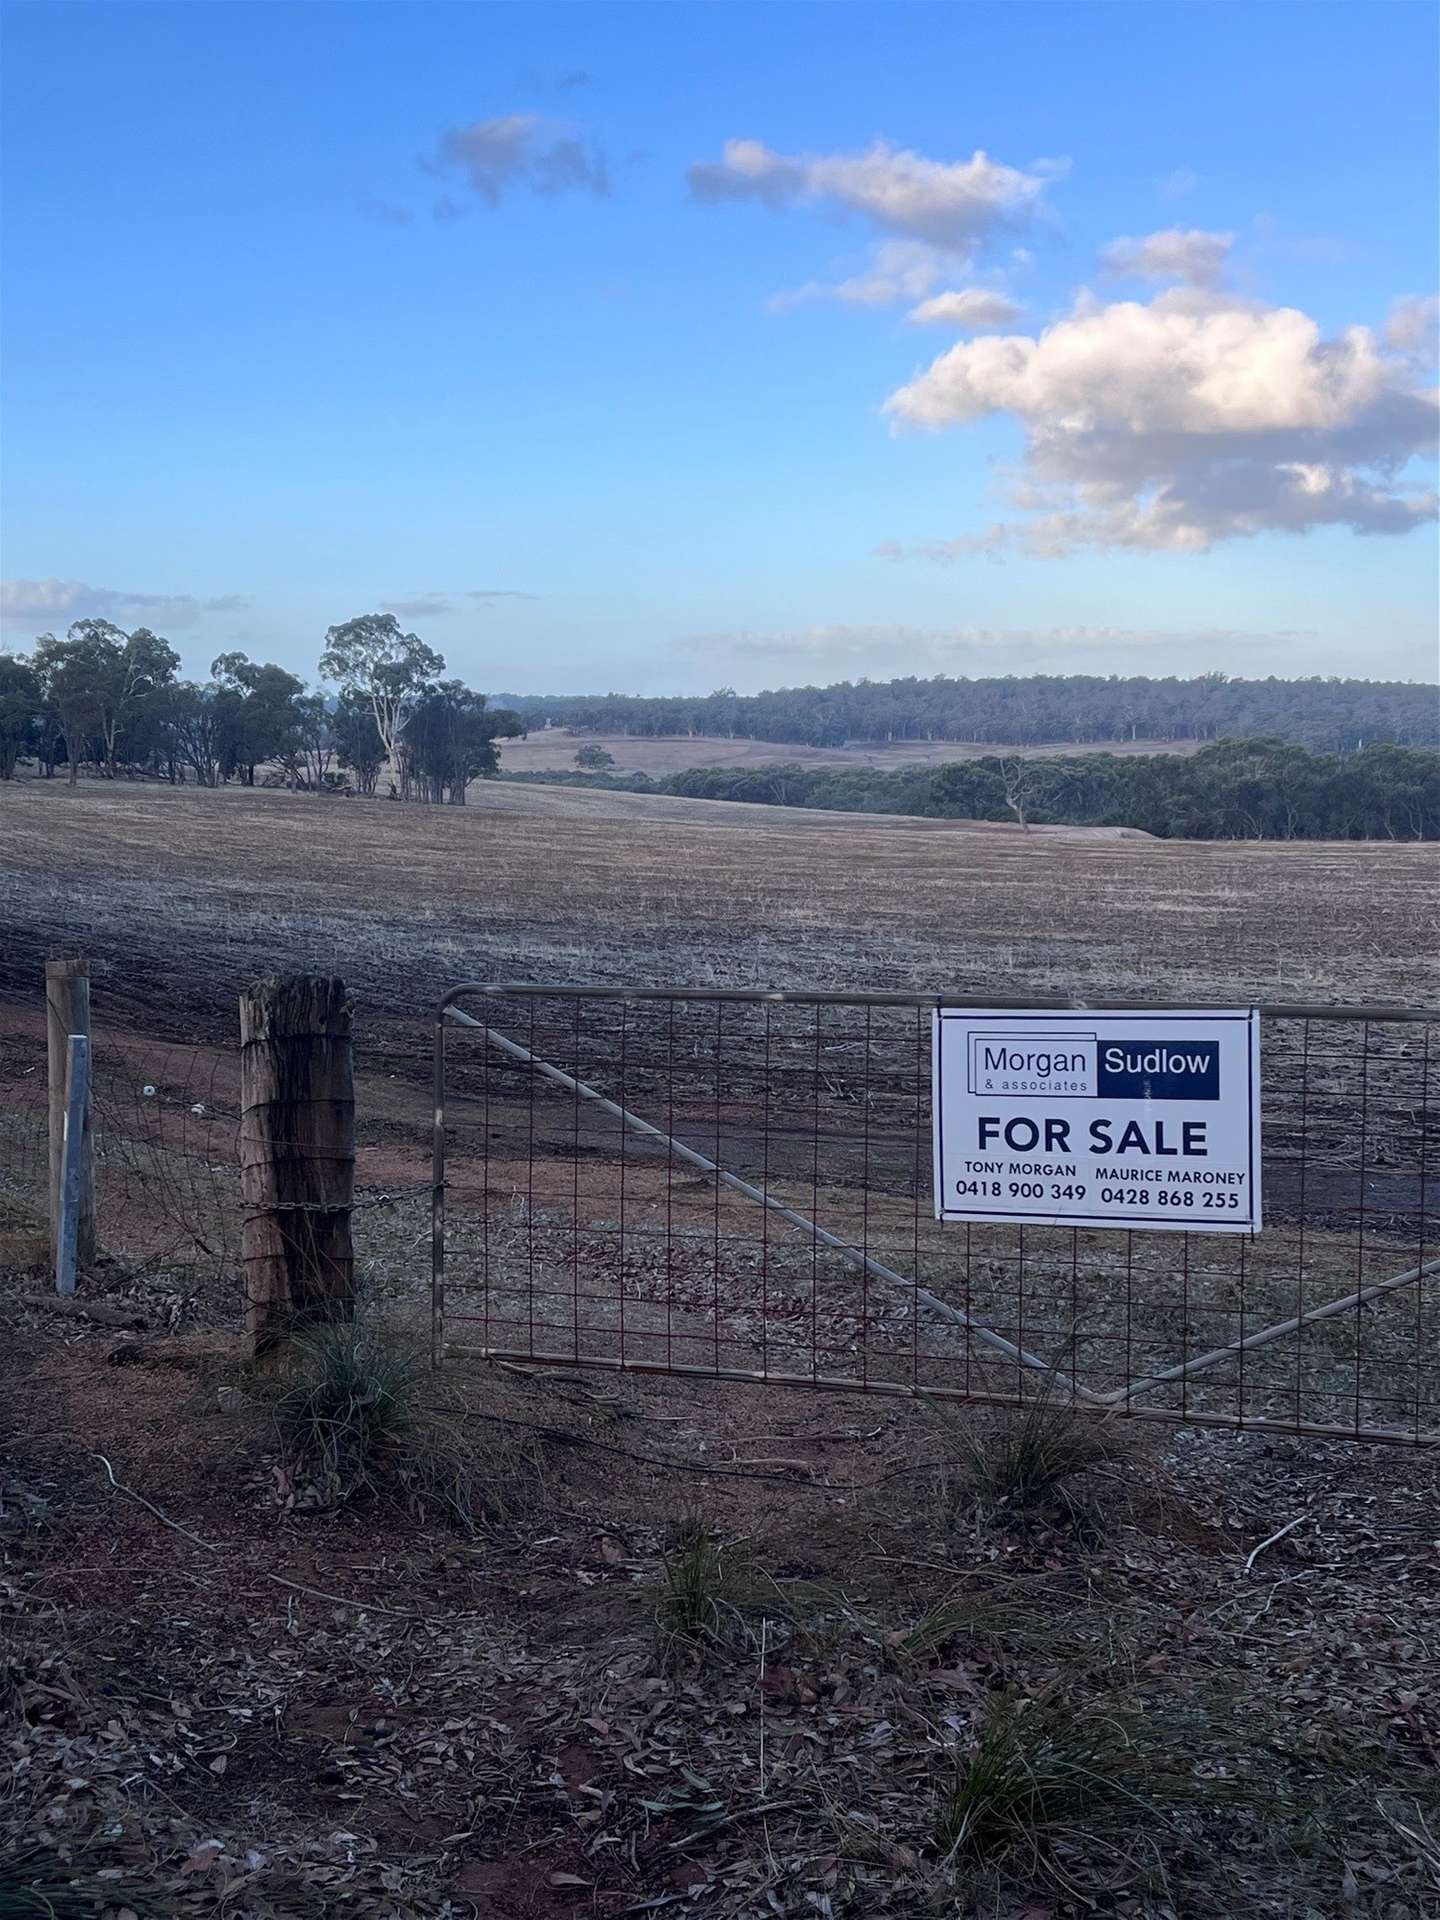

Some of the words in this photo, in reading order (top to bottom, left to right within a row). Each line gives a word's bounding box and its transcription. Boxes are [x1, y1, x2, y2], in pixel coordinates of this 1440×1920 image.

[984, 1047, 1086, 1078] Morgan
[1104, 1048, 1210, 1074] Sudlow
[984, 1079, 994, 1089] &
[1002, 1079, 1088, 1091] associates
[978, 1117, 1071, 1153] FOR
[1088, 1118, 1208, 1156] SALE
[964, 1161, 1004, 1174] TONY
[1009, 1163, 1076, 1177] MORGAN
[1095, 1167, 1163, 1182] MAURICE
[1167, 1171, 1245, 1185] MARONEY
[956, 1180, 1002, 1197] 0418
[1009, 1182, 1044, 1199] 900
[1051, 1184, 1086, 1200] 349
[1101, 1187, 1150, 1205] 0428
[1158, 1190, 1194, 1207] 868
[1202, 1192, 1239, 1209] 255
